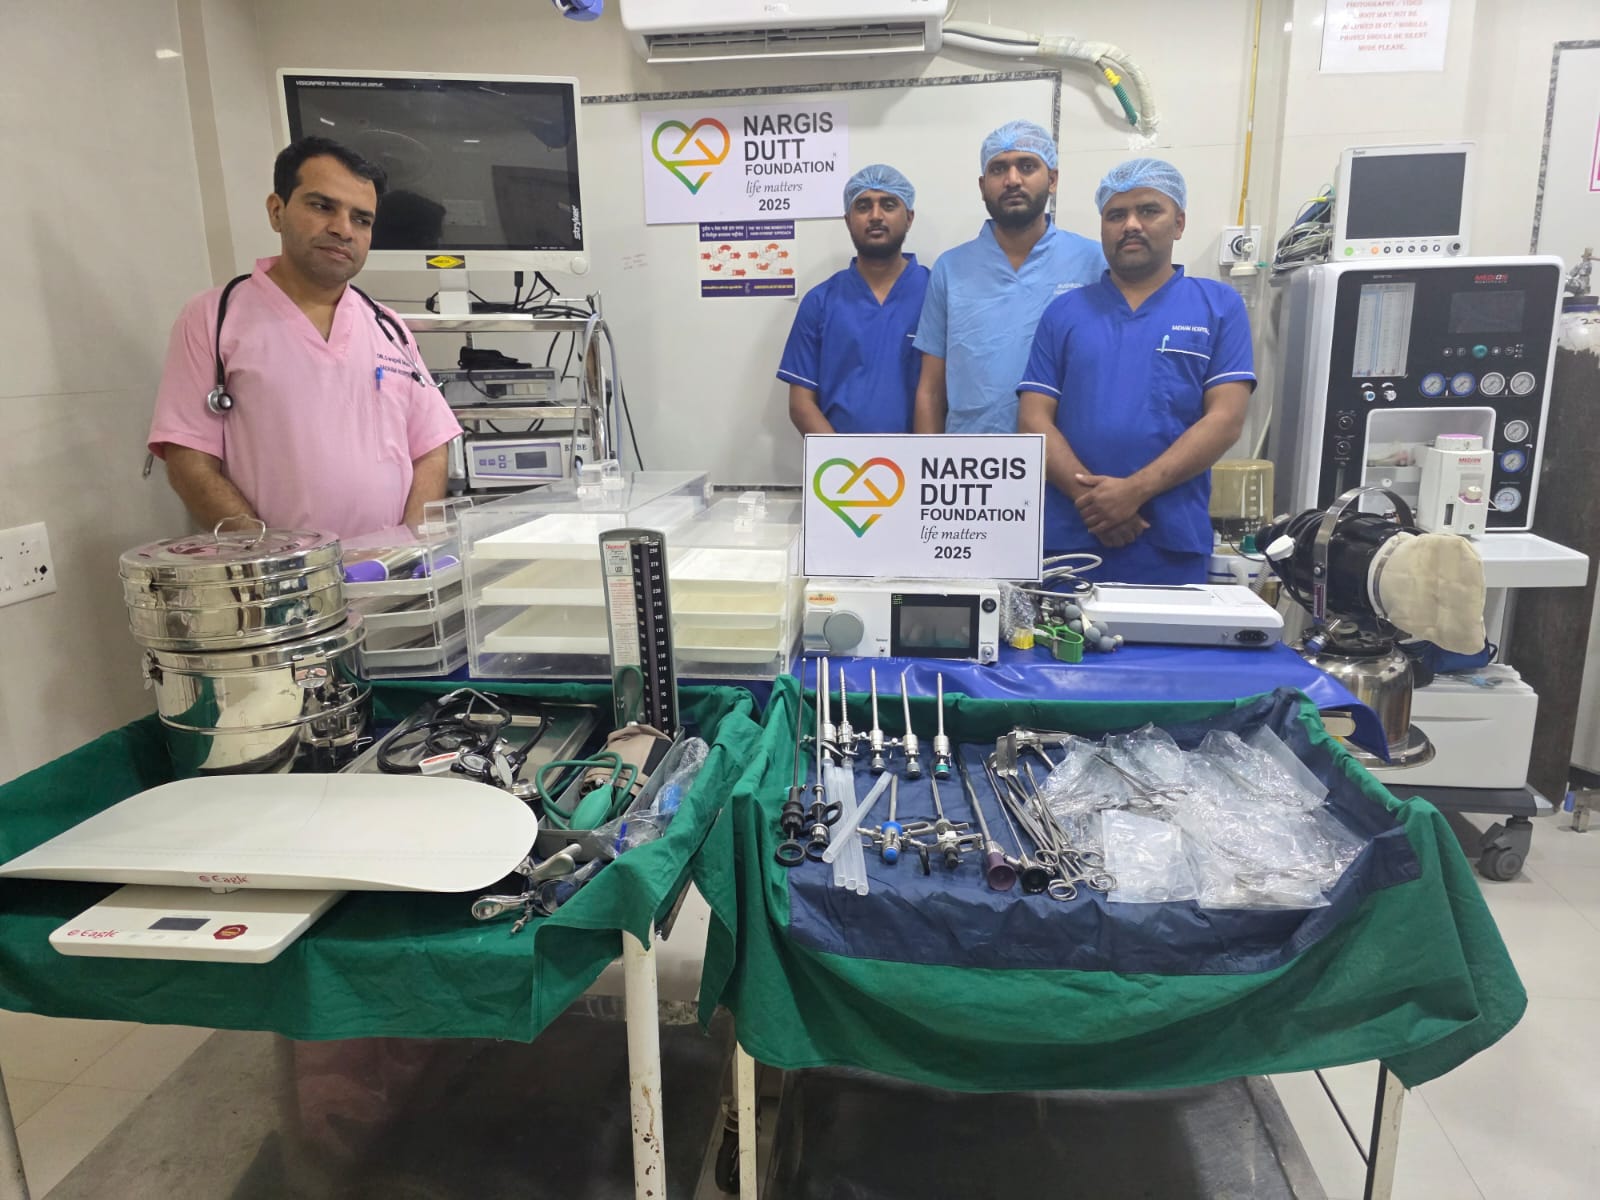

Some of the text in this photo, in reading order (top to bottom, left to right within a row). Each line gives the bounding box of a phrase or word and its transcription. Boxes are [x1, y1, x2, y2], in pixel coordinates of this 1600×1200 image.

[743, 111, 833, 137] NARGIS
[744, 138, 805, 161] DUTT
[745, 160, 834, 176] FOUNDATION
[745, 181, 803, 198] life matters
[758, 198, 791, 211] 2025
[571, 204, 581, 241] stryker
[920, 457, 1027, 480] NARGIS
[920, 483, 993, 506] DUTT
[920, 508, 1026, 522] FOUNDATION
[920, 525, 988, 544] life matters
[934, 546, 972, 559] 2025
[81, 929, 121, 939] Eagle
